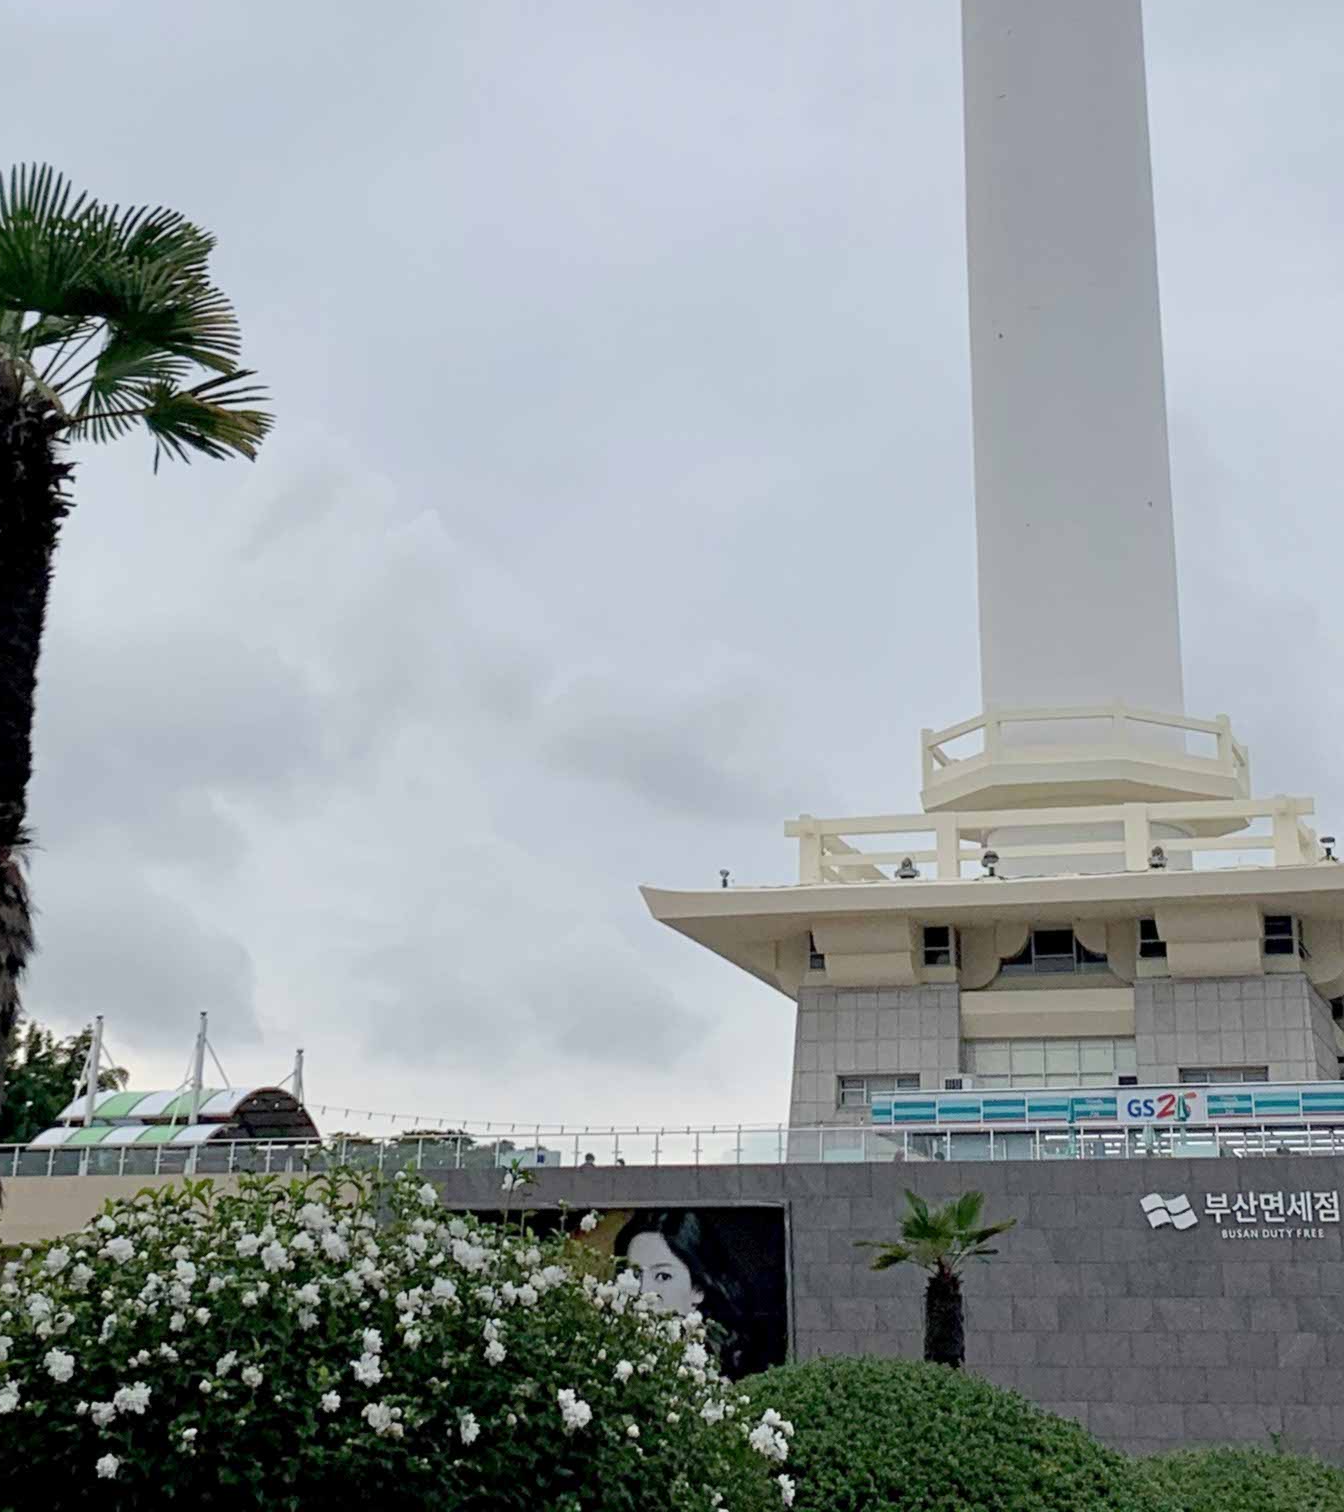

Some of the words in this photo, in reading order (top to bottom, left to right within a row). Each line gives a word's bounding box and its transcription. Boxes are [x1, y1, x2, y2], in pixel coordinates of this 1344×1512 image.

[1204, 1190, 1341, 1224] 부산면세점
[1221, 1228, 1259, 1239] BUSAN
[1261, 1228, 1293, 1238] DUTY
[1296, 1228, 1324, 1238] FREE
